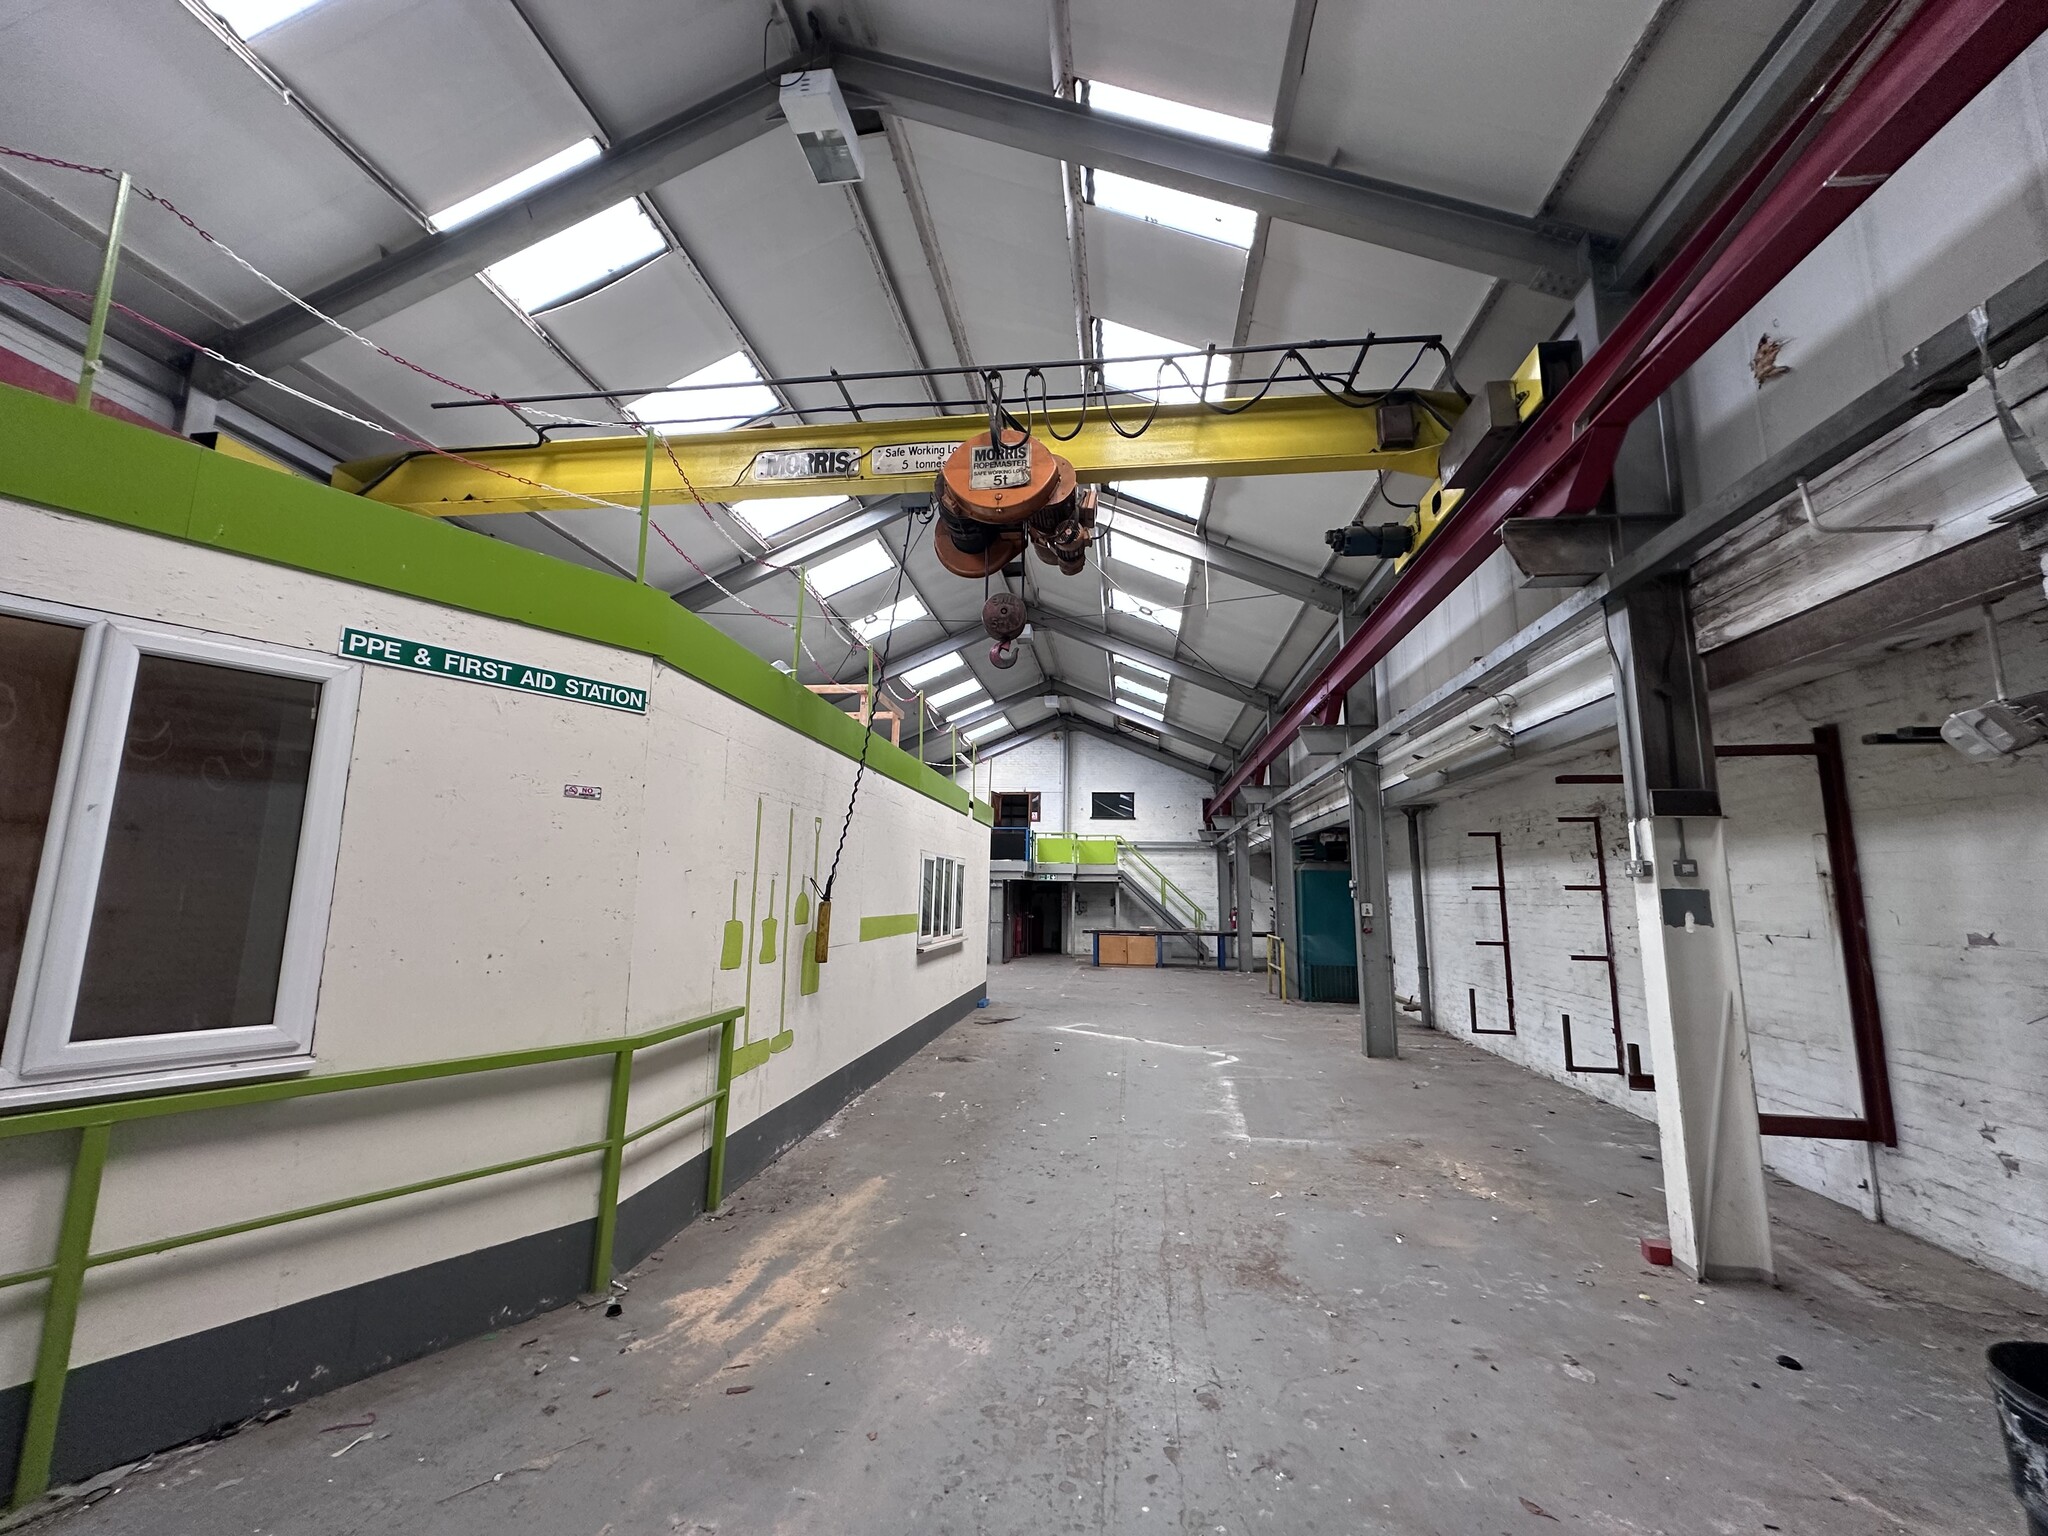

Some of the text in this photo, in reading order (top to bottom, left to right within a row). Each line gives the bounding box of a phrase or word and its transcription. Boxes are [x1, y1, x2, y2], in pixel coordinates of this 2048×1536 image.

[885, 445, 958, 457] Safe Working Lo
[975, 448, 1026, 461] MORRIS
[767, 452, 849, 475] MORRIS
[902, 460, 946, 469] 5 tonnes
[974, 460, 1027, 469] ROPEMASTER
[993, 475, 1008, 485] 5t
[349, 633, 643, 707] PPE & FIRST AID STATION
